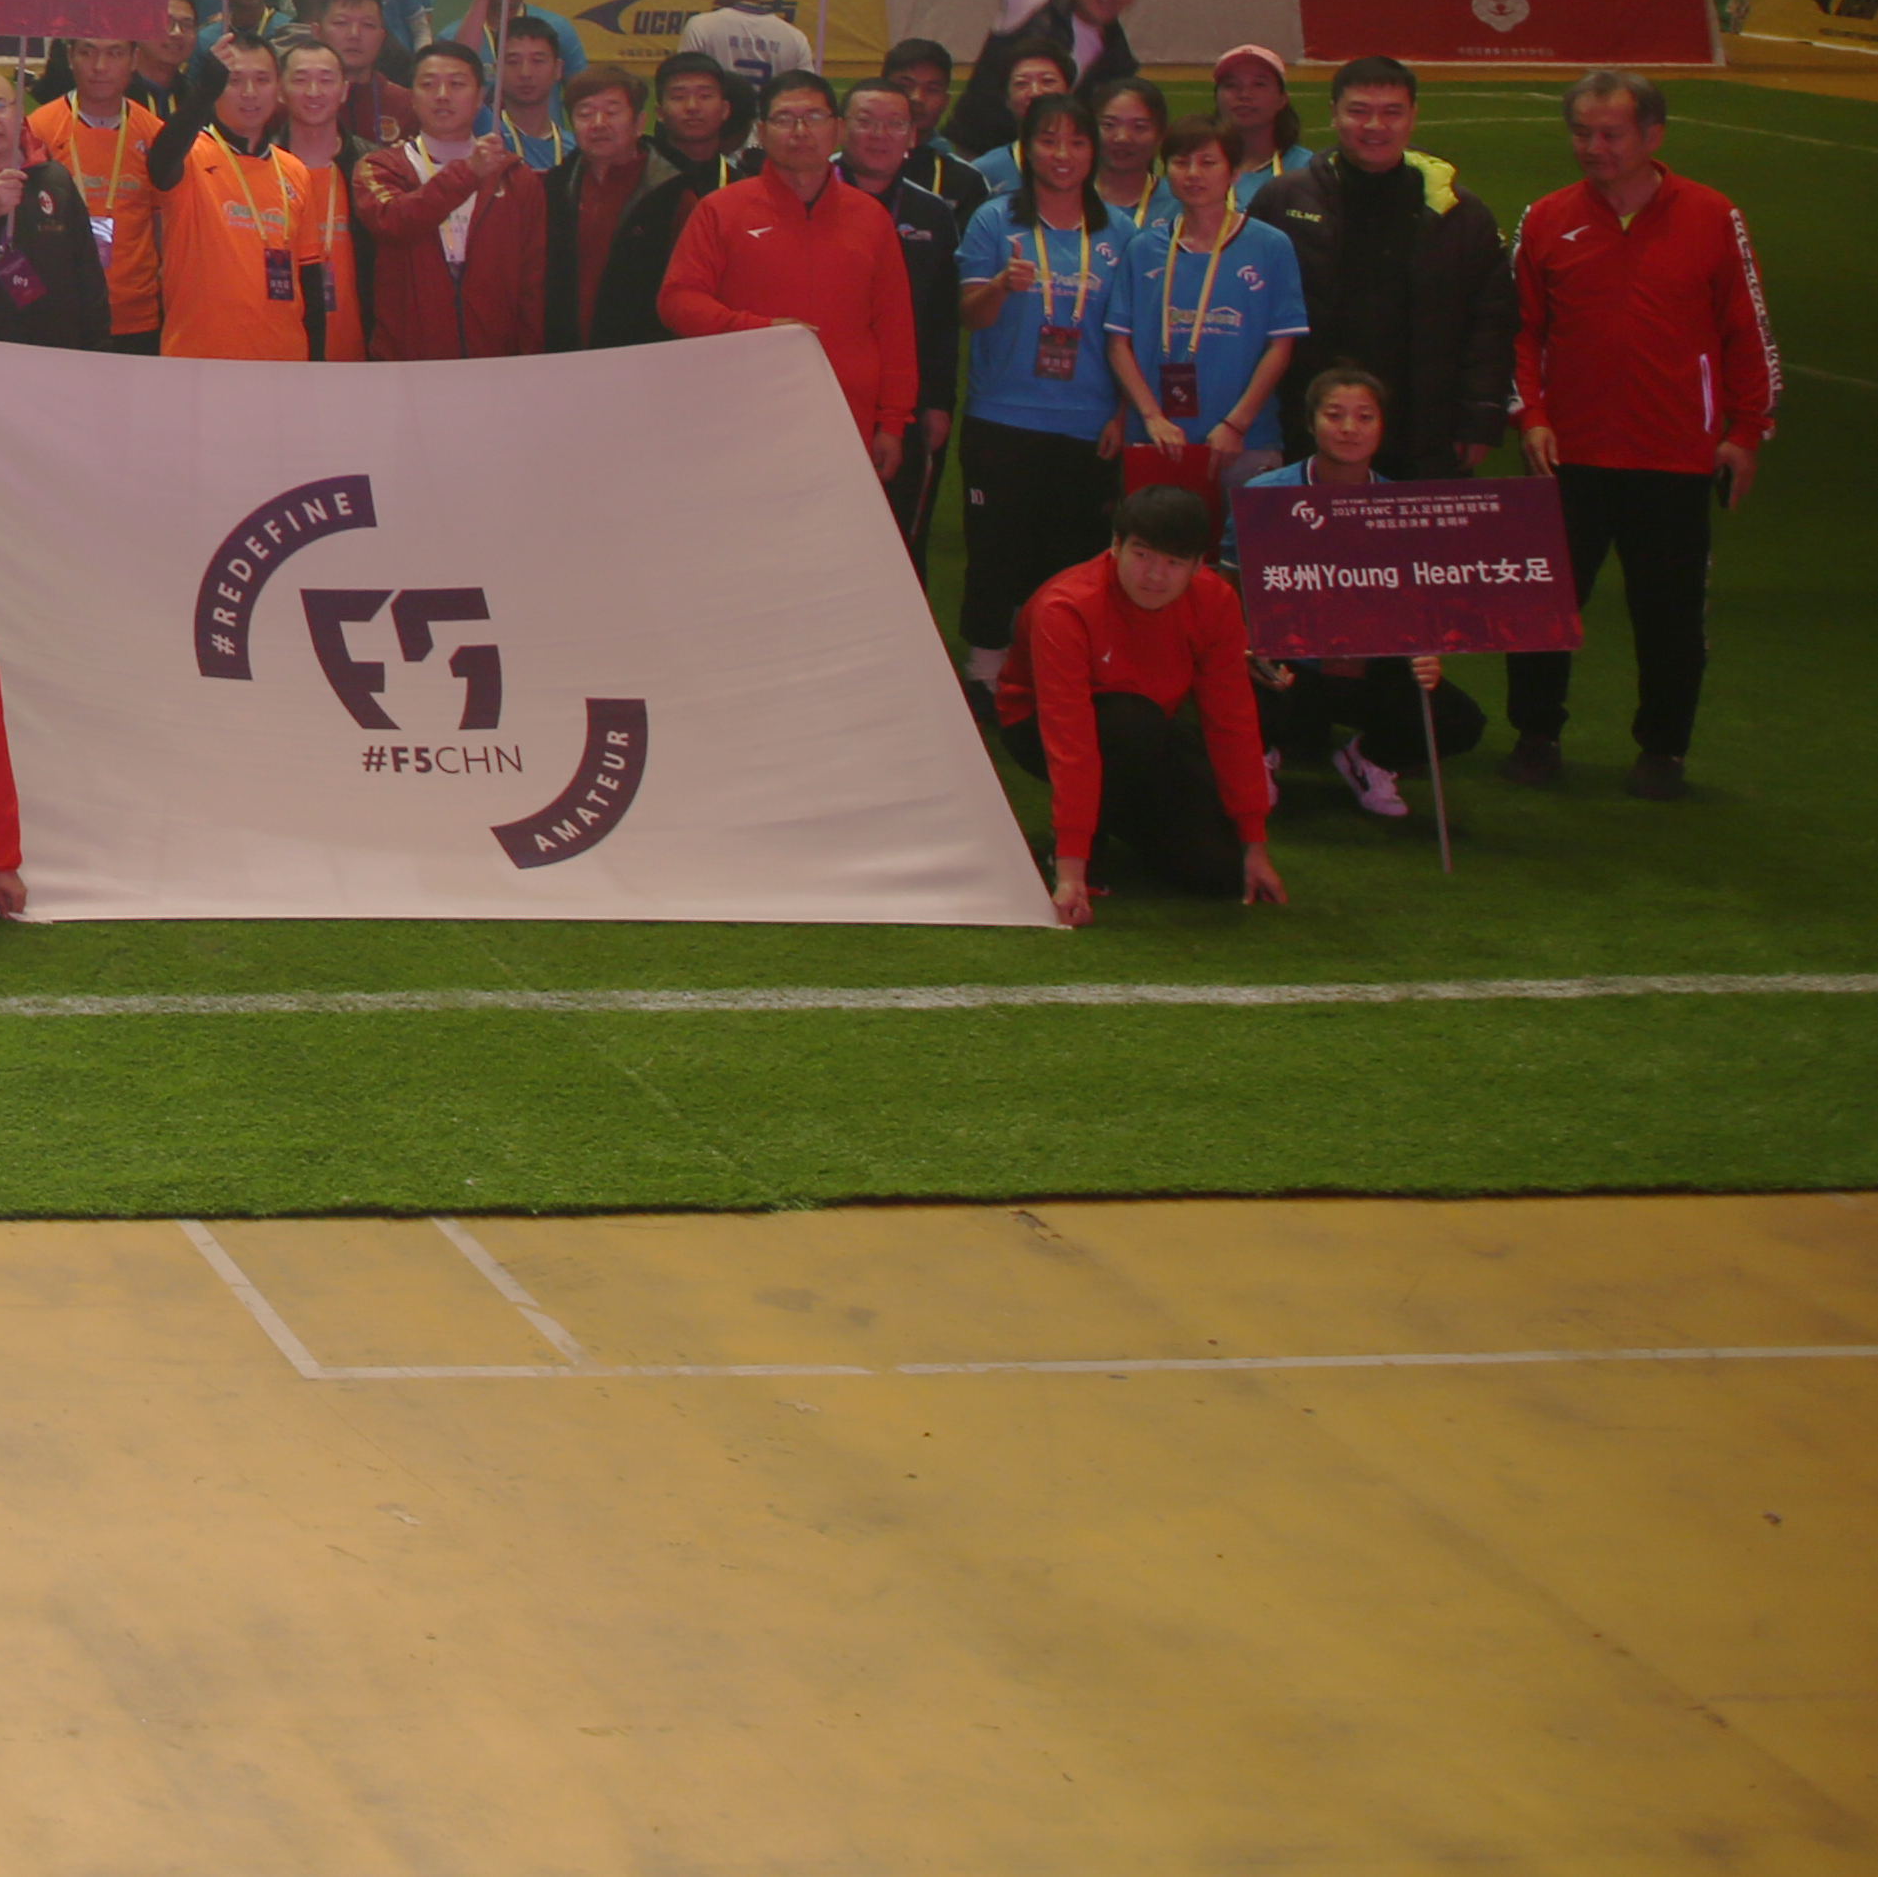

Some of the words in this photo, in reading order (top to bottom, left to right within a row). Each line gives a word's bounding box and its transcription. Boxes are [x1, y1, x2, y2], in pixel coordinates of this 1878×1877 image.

[212, 493, 355, 657] #REDEFINE
[1263, 563, 1399, 591] 郑州Young
[1413, 557, 1554, 585] Heart女足
[532, 728, 631, 853] AMATEUR
